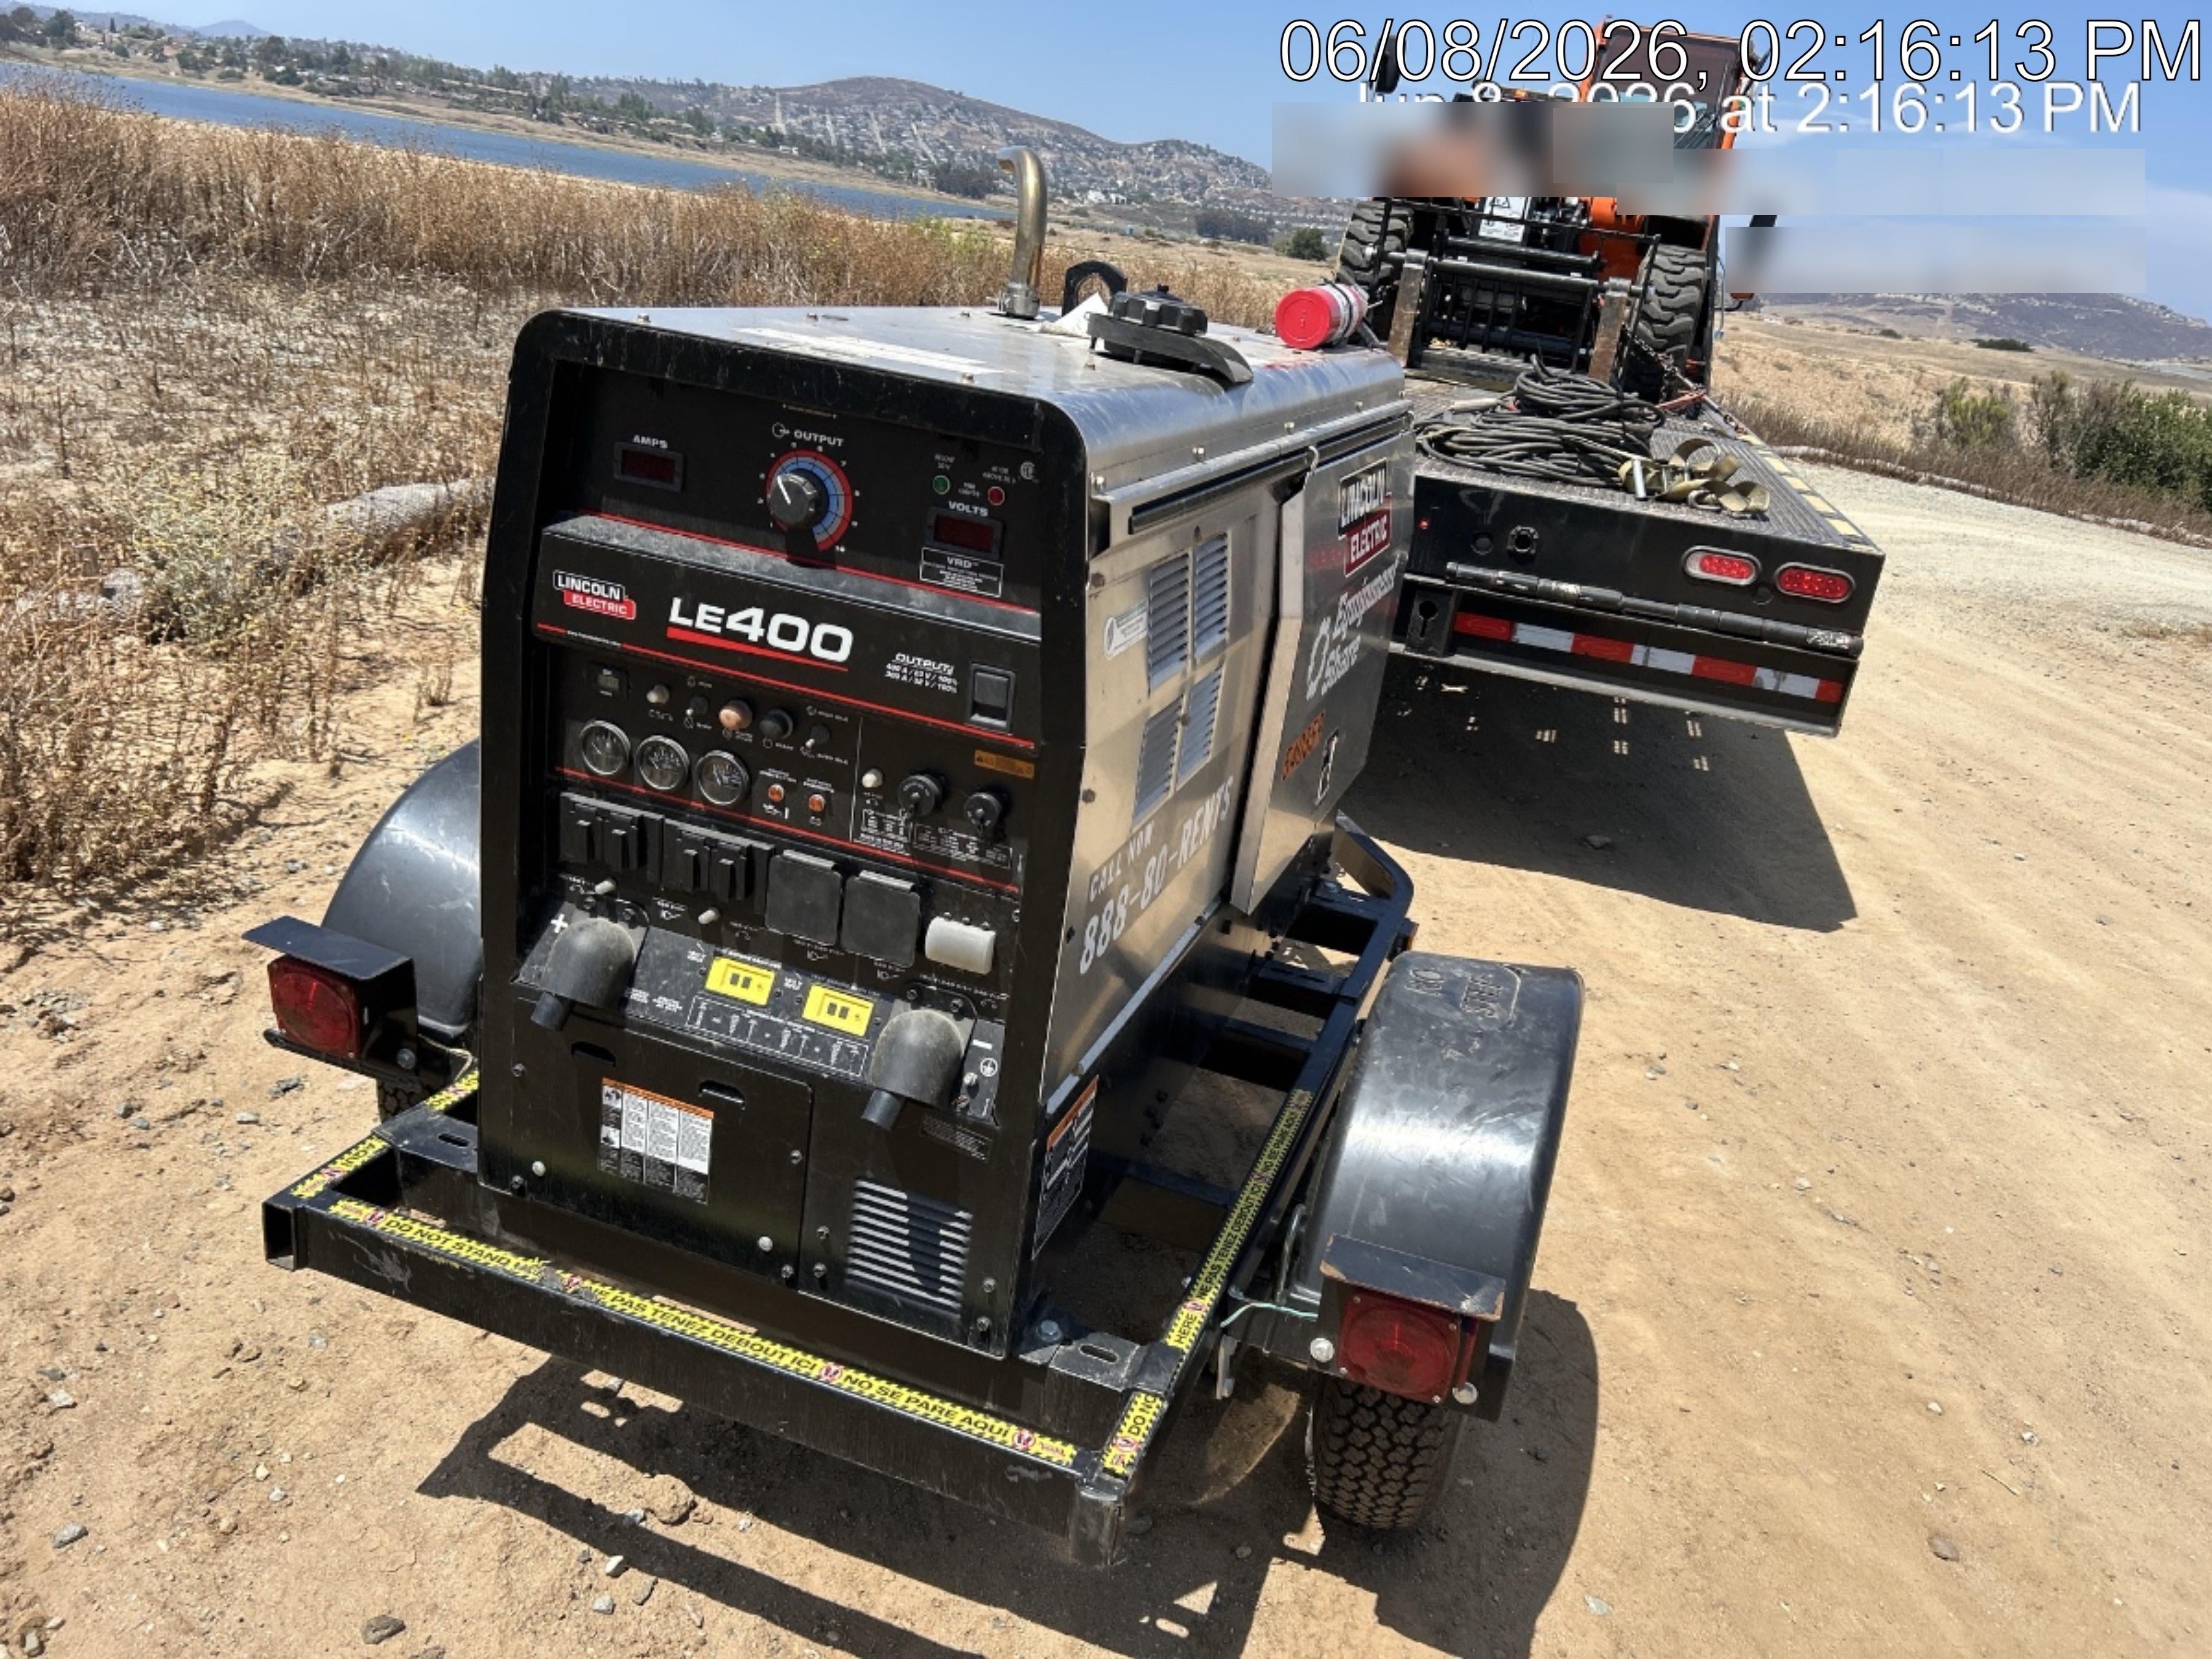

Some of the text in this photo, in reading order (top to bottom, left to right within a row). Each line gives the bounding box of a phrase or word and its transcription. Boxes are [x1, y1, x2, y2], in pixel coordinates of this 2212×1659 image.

[633, 434, 668, 449] AMPS
[794, 429, 844, 447] OUTPUT
[949, 501, 989, 517] VOLTS
[1351, 514, 1387, 562] ELECTRIC
[558, 575, 621, 600] LINCOLN
[572, 593, 627, 614] ELECTRIC
[669, 596, 853, 662] LE400
[1128, 820, 1155, 865] NOW
[1080, 775, 1234, 975] 888-80-RENTS
[385, 1220, 511, 1266] DO NOT STAND
[610, 1295, 648, 1311] PAS
[651, 1308, 709, 1333] TENEZ
[711, 1329, 790, 1360] DEBOUT
[790, 1356, 818, 1370] ICI
[1174, 1312, 1198, 1344] HERE
[843, 1375, 1010, 1437] NO SE PARE AQUI
[1128, 1415, 1146, 1436] DO
